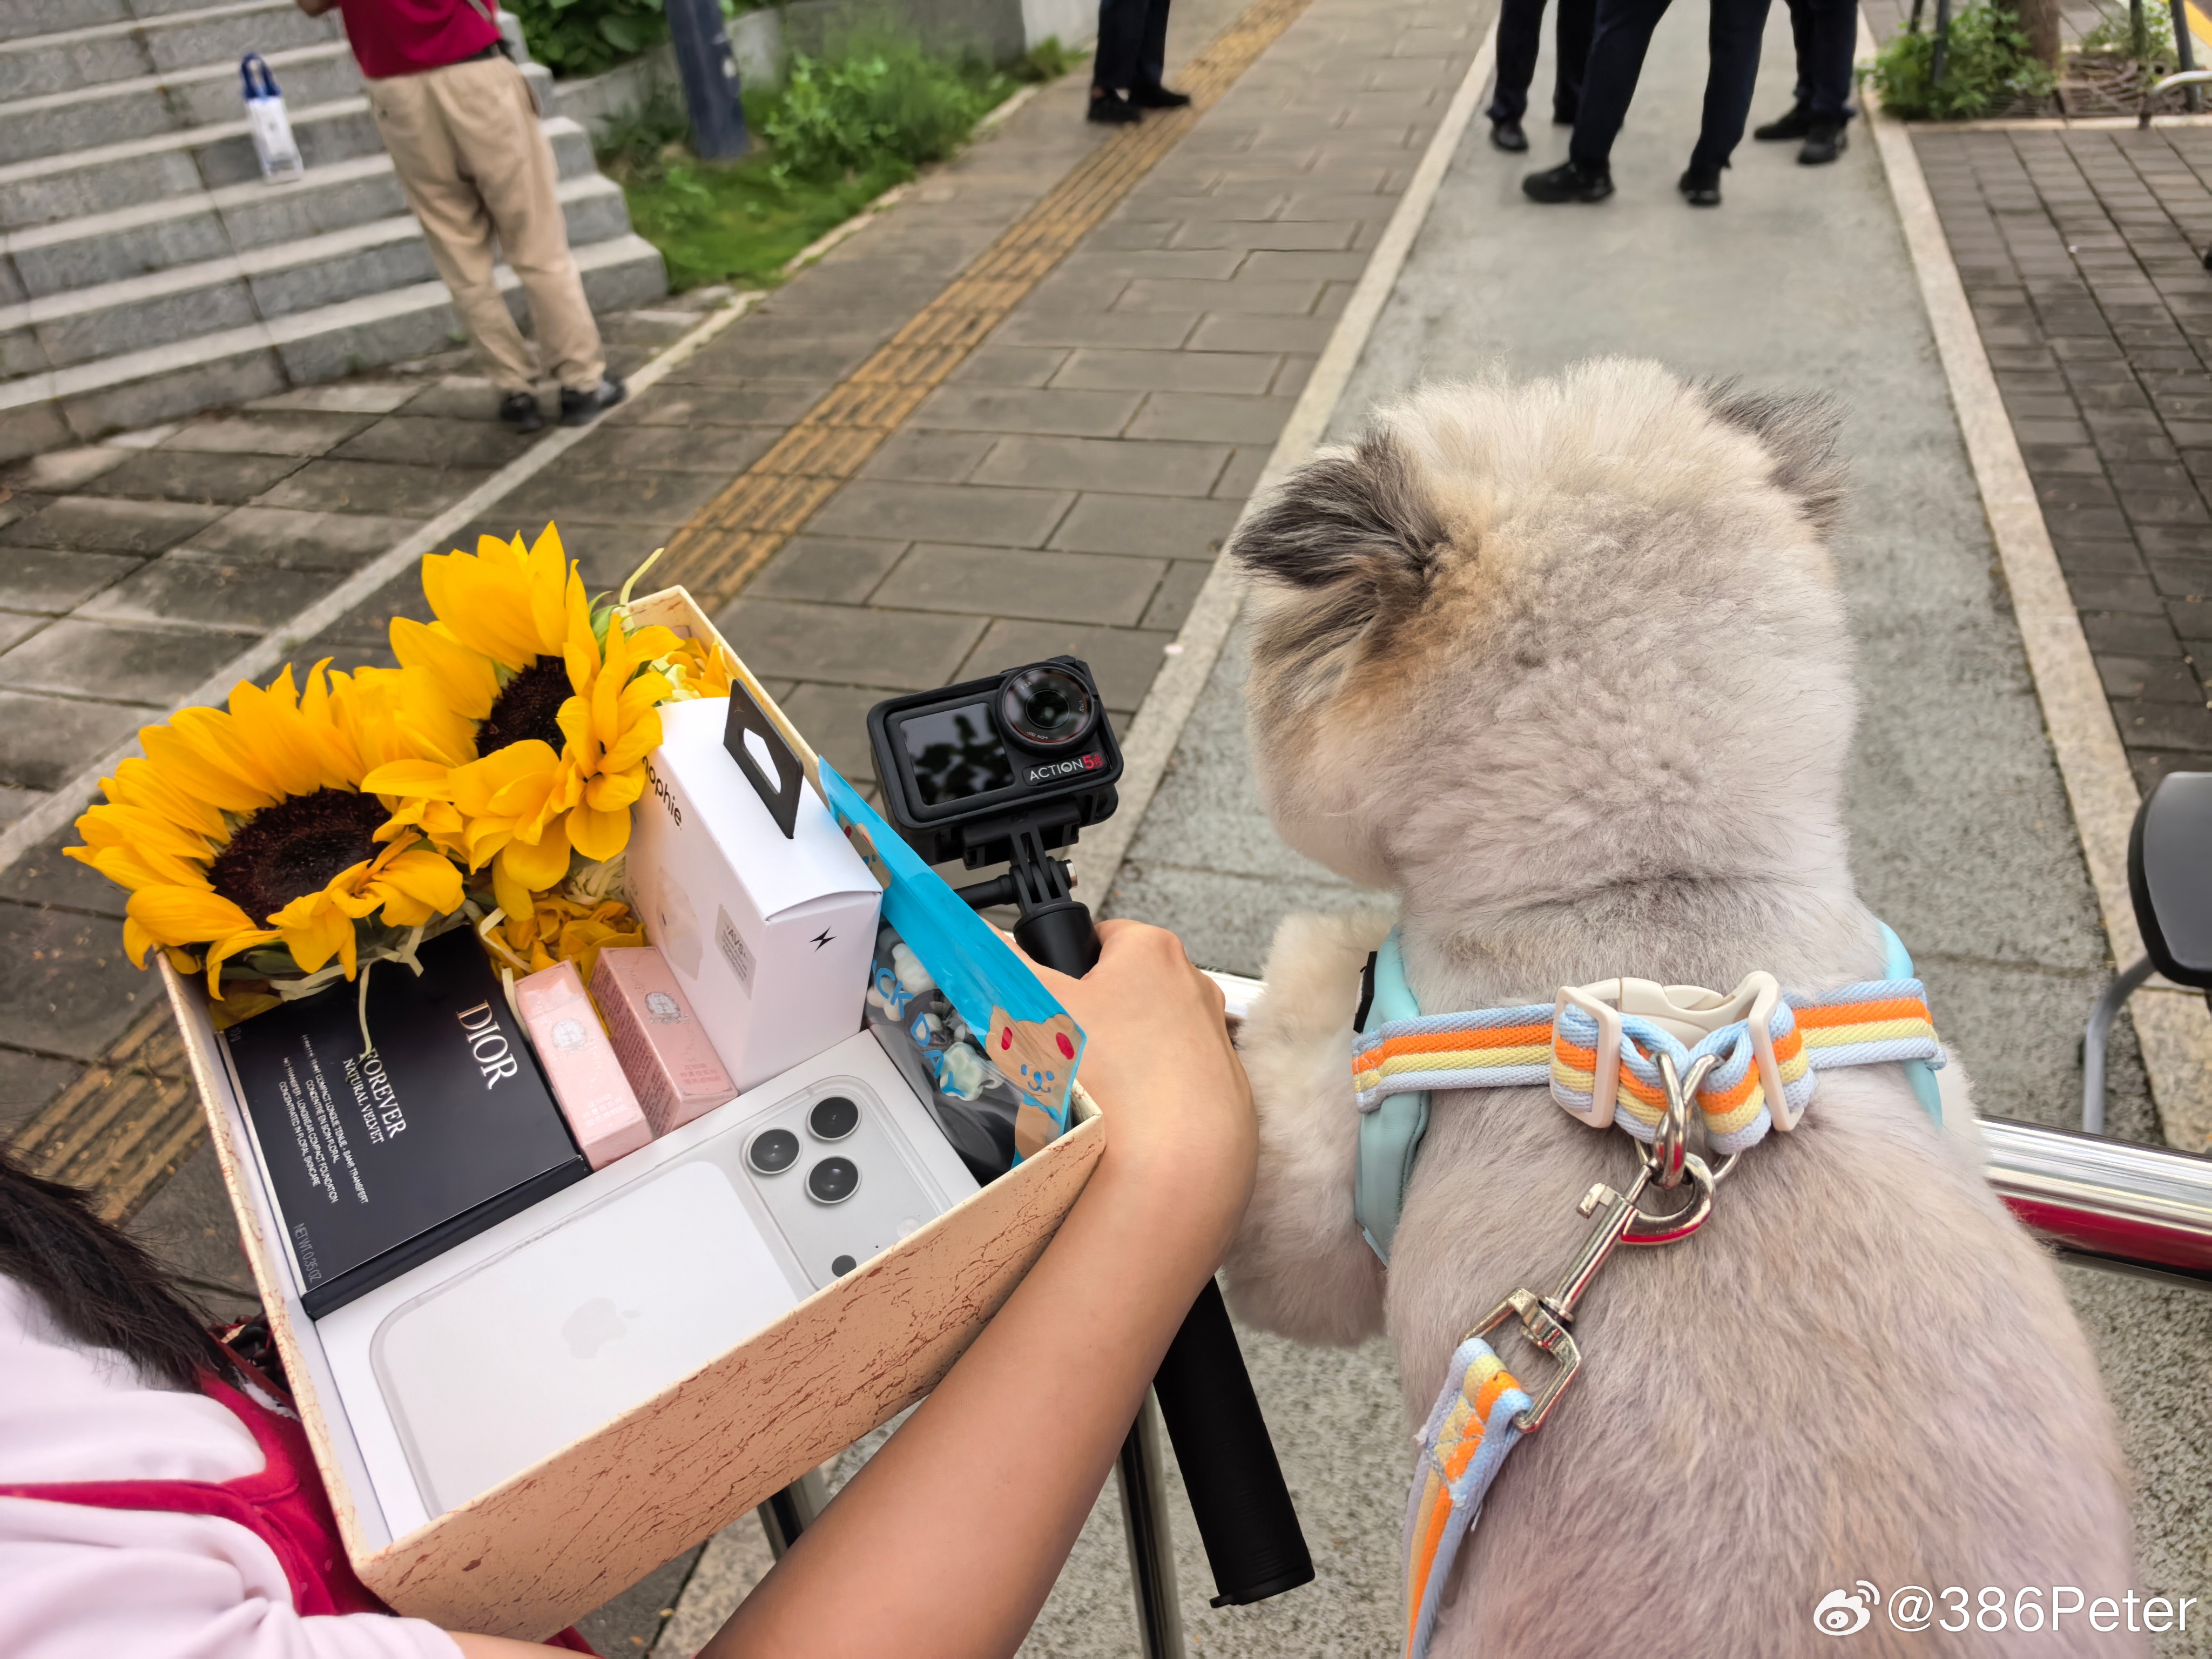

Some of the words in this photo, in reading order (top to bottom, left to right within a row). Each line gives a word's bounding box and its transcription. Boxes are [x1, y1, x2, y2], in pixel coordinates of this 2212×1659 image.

[728, 929, 744, 955] AVS
[456, 1000, 518, 1090] DIOR
[872, 959, 914, 1019] CK
[911, 1011, 966, 1098] DAY
[279, 1081, 300, 1127] CONCENTRATED
[342, 1057, 369, 1106] NATURAL
[361, 1103, 385, 1144] VELVET
[359, 1047, 407, 1150] FOREVER
[294, 1125, 303, 1134] IN
[296, 1132, 310, 1157] FLORAL
[296, 1099, 315, 1134] LONGWEAR
[308, 1132, 326, 1163] COMPACT
[318, 1162, 339, 1203] FOUNDATION
[315, 1074, 332, 1102] COMPACT
[325, 1101, 340, 1127] LONGUE
[334, 1125, 348, 1148] TENUE
[342, 1150, 355, 1169] SANS
[349, 1167, 369, 1204] TRANSFERT
[318, 1114, 328, 1124] EN
[327, 1138, 341, 1164] FLORAL
[304, 1155, 321, 1187] SKINCARE
[293, 1223, 308, 1239] NET
